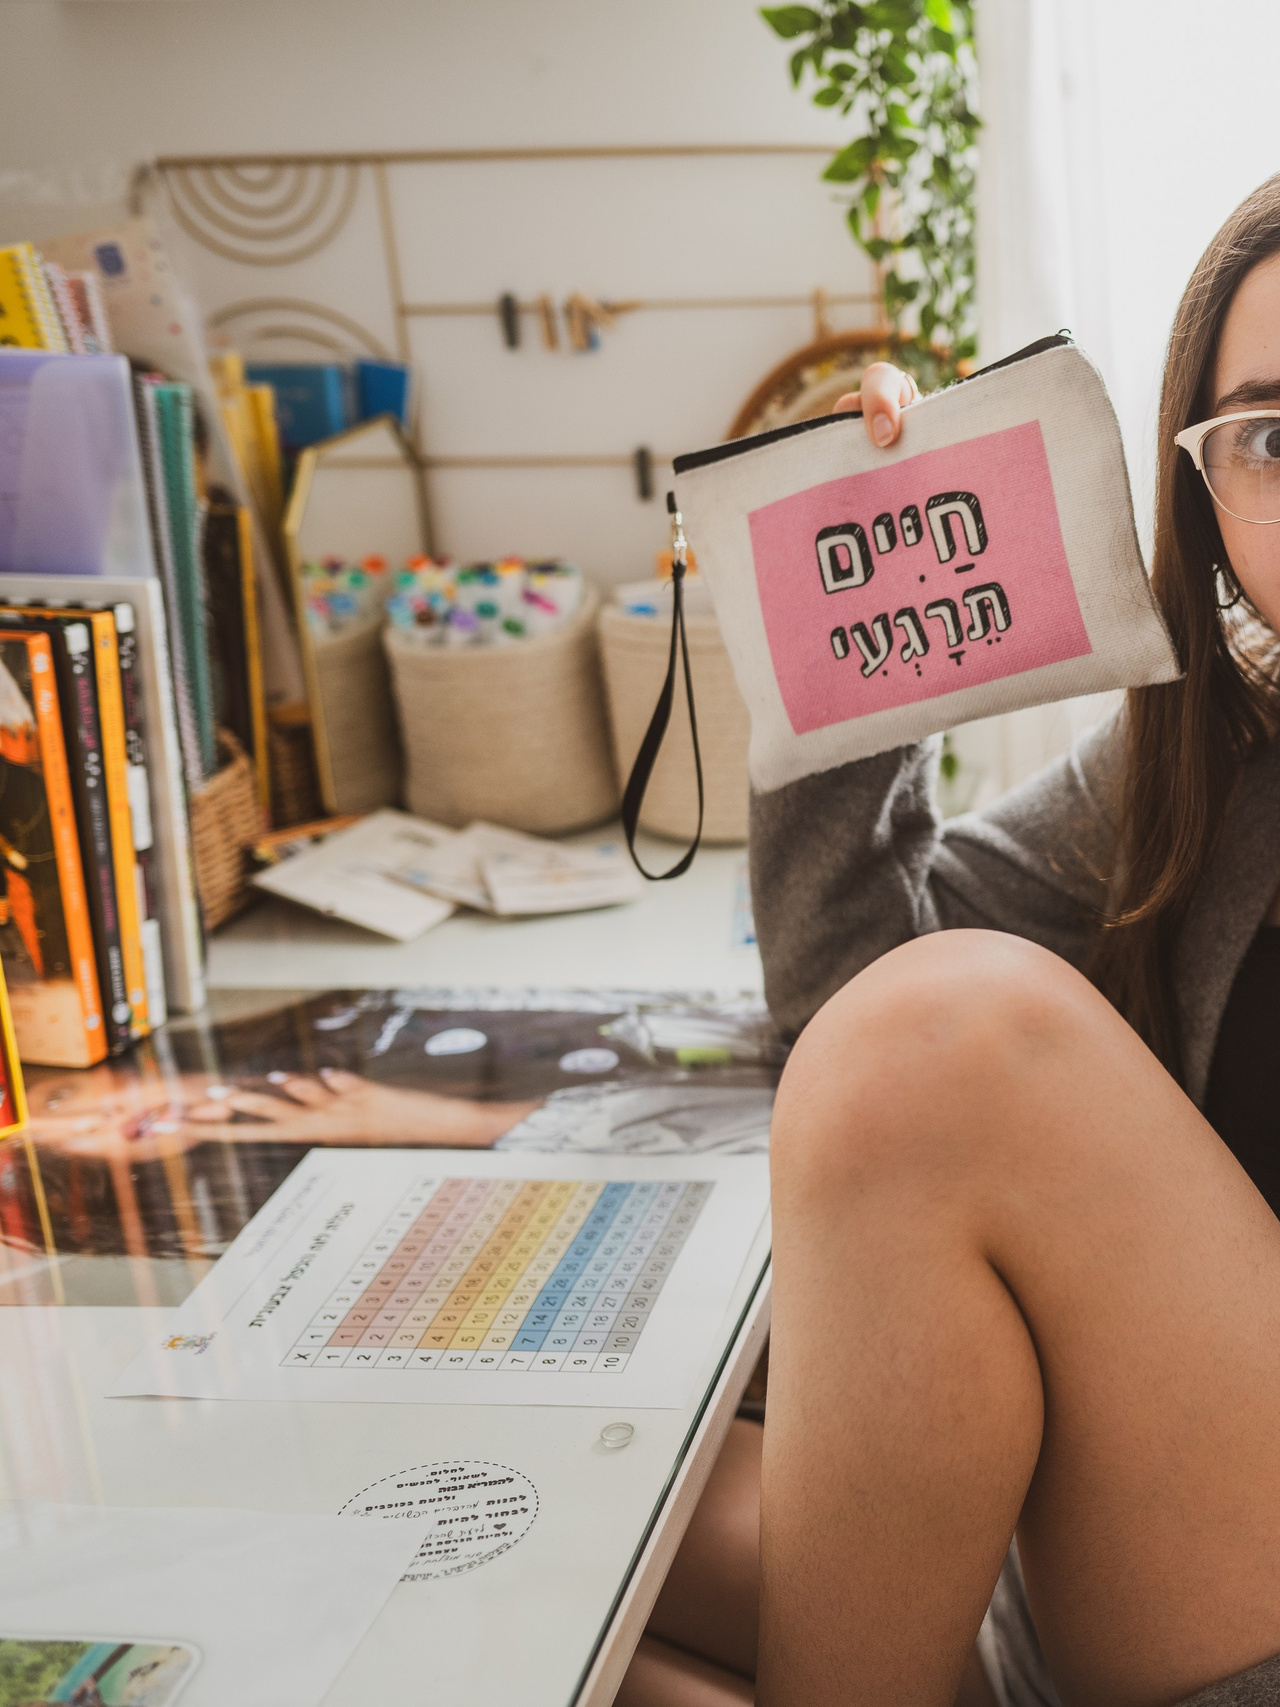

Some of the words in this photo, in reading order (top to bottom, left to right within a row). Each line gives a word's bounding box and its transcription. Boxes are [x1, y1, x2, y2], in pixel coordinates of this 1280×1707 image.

[352, 1313, 367, 1321] 2
[520, 1336, 535, 1344] 7
[531, 1314, 547, 1325] 14
[356, 1353, 371, 1361] 2
[368, 1332, 384, 1341] 2
[383, 1314, 395, 1322] 4
[386, 1354, 402, 1362] 3
[399, 1333, 414, 1341] 3
[412, 1314, 427, 1322] 6
[419, 1355, 432, 1363] 4
[431, 1334, 444, 1343] 4
[442, 1314, 457, 1322] 8
[448, 1355, 463, 1363] 5
[460, 1334, 475, 1343] 5
[471, 1312, 488, 1323] 10
[479, 1356, 494, 1364] 6
[490, 1335, 506, 1344] 6
[501, 1313, 518, 1324] 12
[541, 1357, 556, 1365] 8
[552, 1337, 567, 1345] 8
[562, 1314, 578, 1325] 16
[572, 1358, 587, 1366] 9
[582, 1337, 597, 1346] 9
[592, 1315, 608, 1326] 18
[603, 1357, 619, 1367] 10
[612, 1336, 629, 1347] 10
[621, 1316, 639, 1328] 20
[438, 1484, 464, 1492] גבוה
[467, 1476, 513, 1488] להמריא
[418, 1495, 455, 1504] ולגעת
[486, 1494, 526, 1505] להנות
[365, 1501, 413, 1511] בכוכבים
[434, 1500, 479, 1513] מהדברים
[485, 1507, 528, 1518] לבחור
[437, 1514, 478, 1525] להיות
[436, 1537, 472, 1545] הגרסה
[477, 1531, 512, 1539] ולהיות
